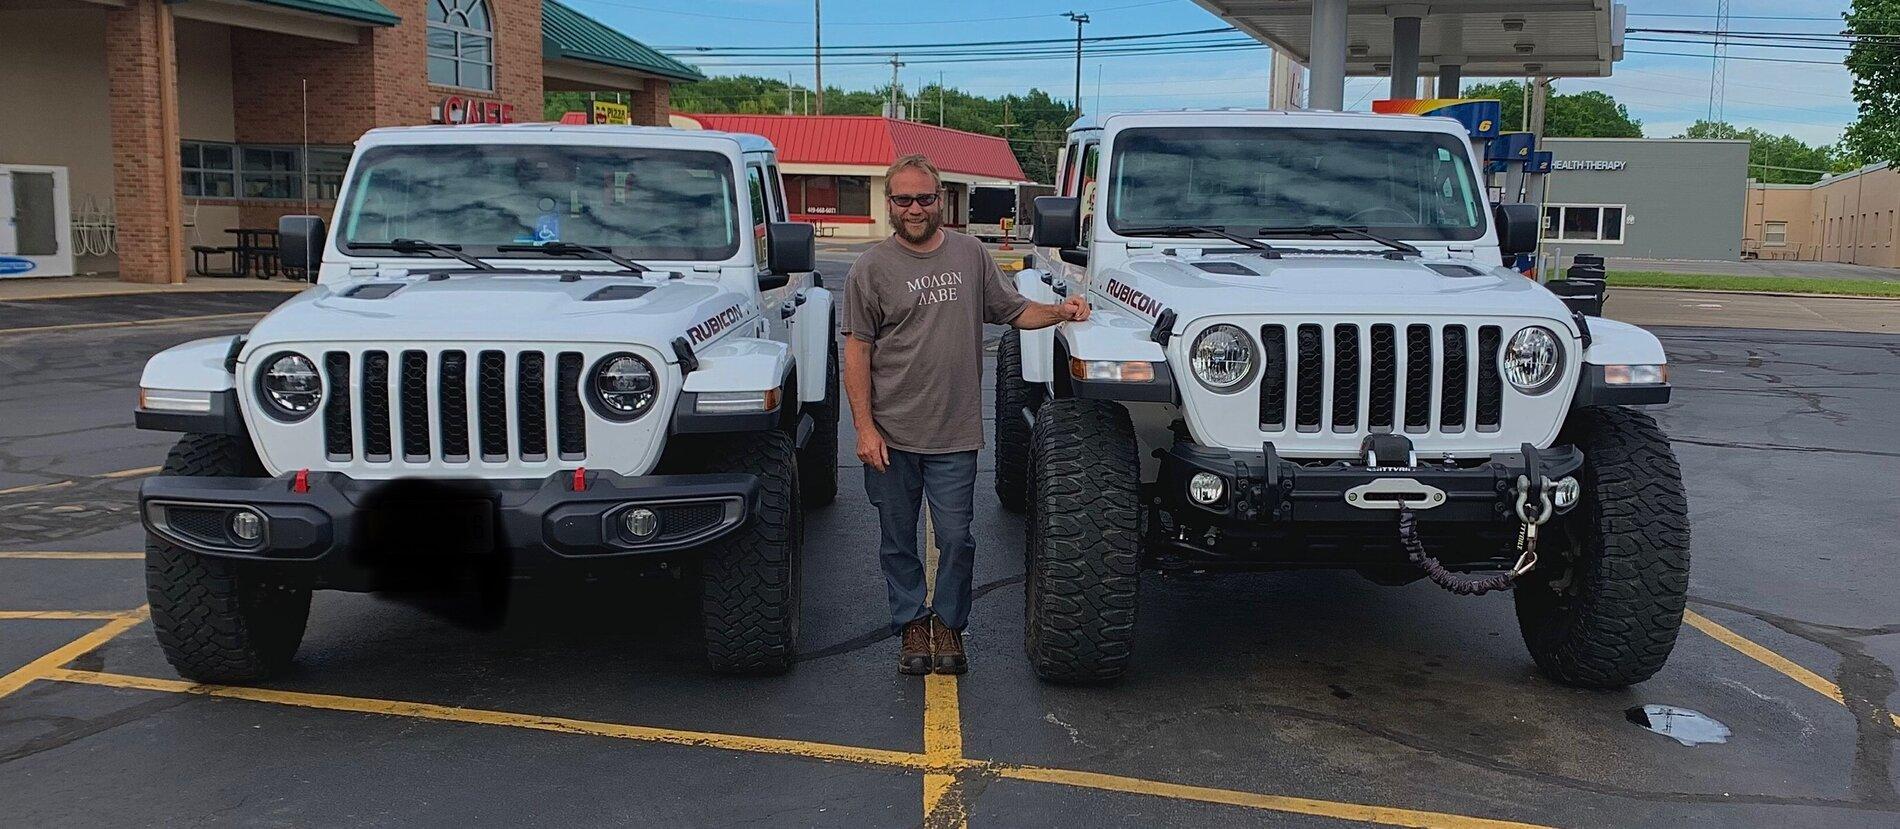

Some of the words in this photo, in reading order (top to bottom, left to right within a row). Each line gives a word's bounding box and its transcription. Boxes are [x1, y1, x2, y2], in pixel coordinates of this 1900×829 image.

[443, 95, 514, 124] CAFE
[1479, 120, 1492, 132] 6
[1518, 147, 1528, 156] 4
[1540, 161, 1549, 169] 2
[1551, 160, 1584, 170] HEALTH
[1585, 160, 1627, 171] THERAPY
[1106, 278, 1163, 318] RUBICON
[686, 304, 744, 346] RUBICON
